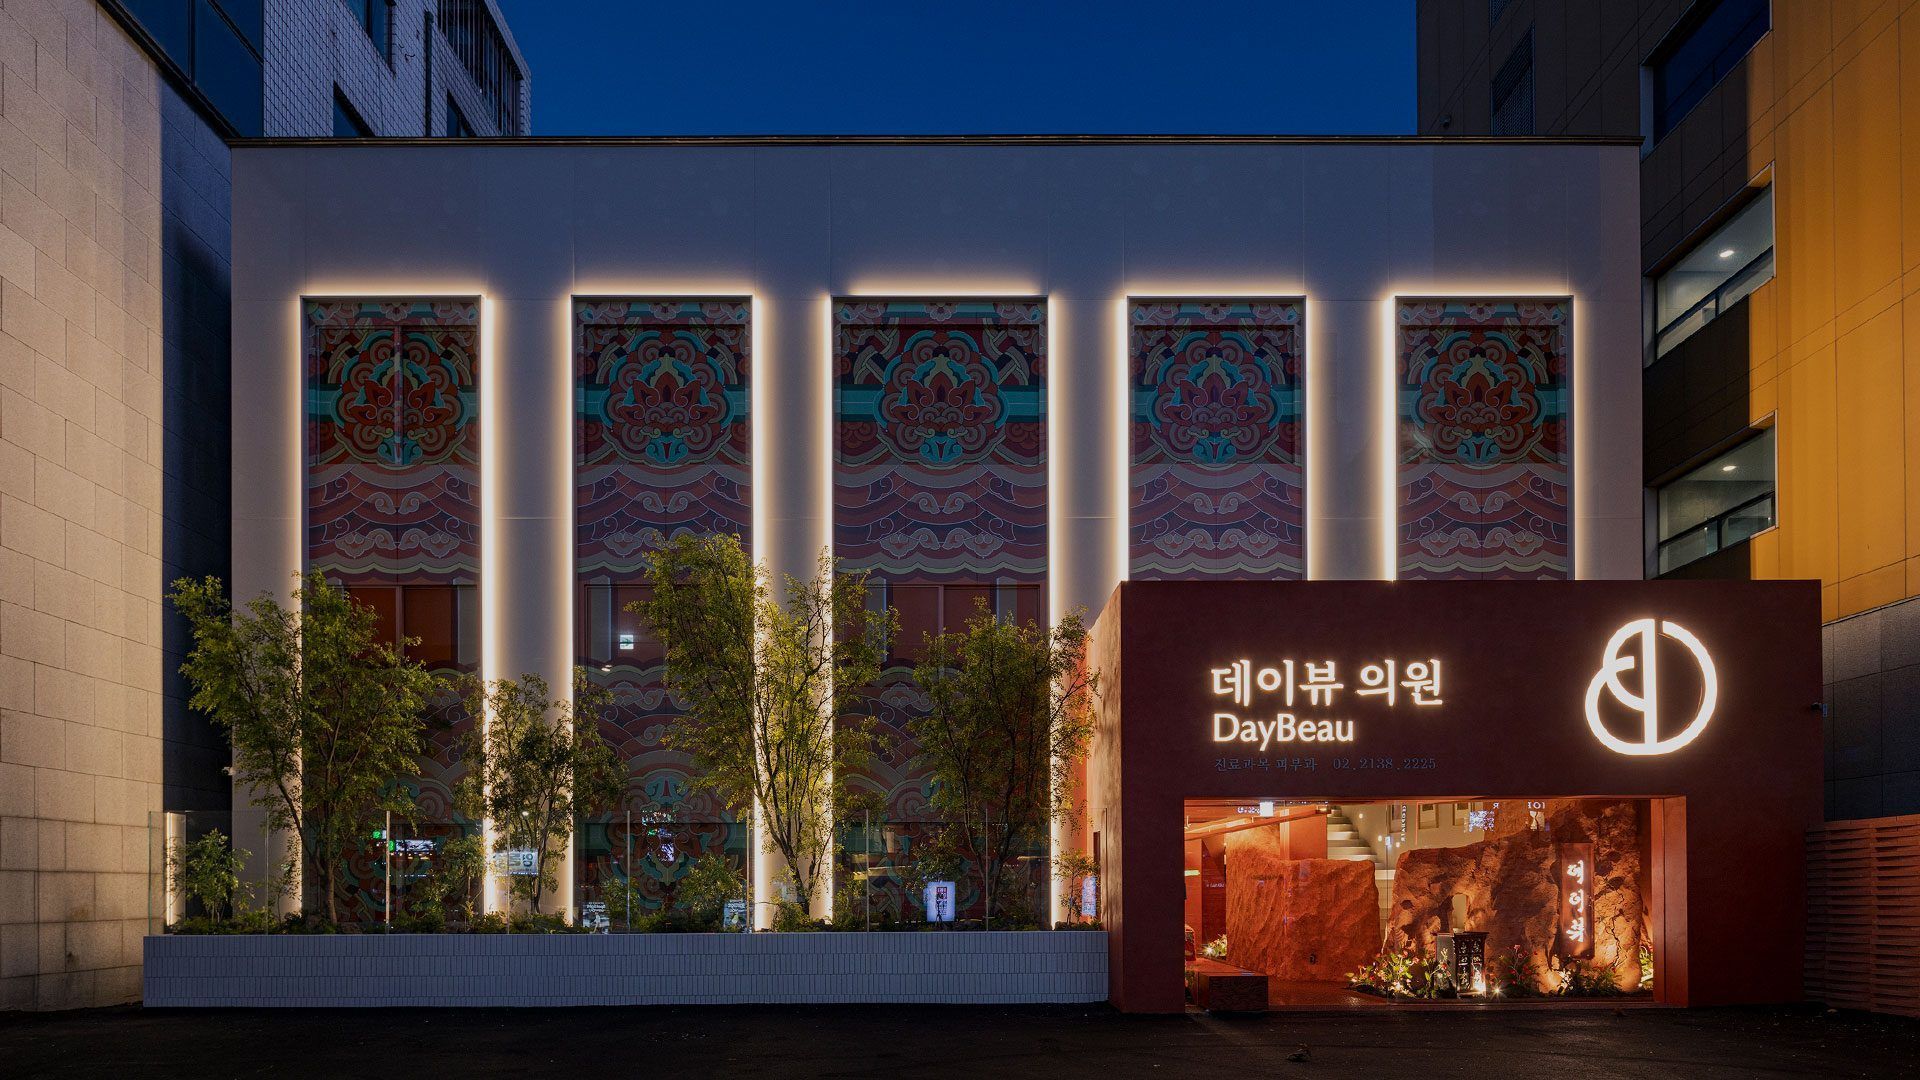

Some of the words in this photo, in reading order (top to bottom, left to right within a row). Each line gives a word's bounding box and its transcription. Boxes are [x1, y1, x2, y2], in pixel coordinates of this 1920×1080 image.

[1210, 658, 1345, 707] 데이뷰
[1355, 658, 1443, 707] 의원
[1212, 712, 1355, 752] DayBeau
[1214, 757, 1270, 773] 진료과목
[1275, 757, 1319, 772] 피부과
